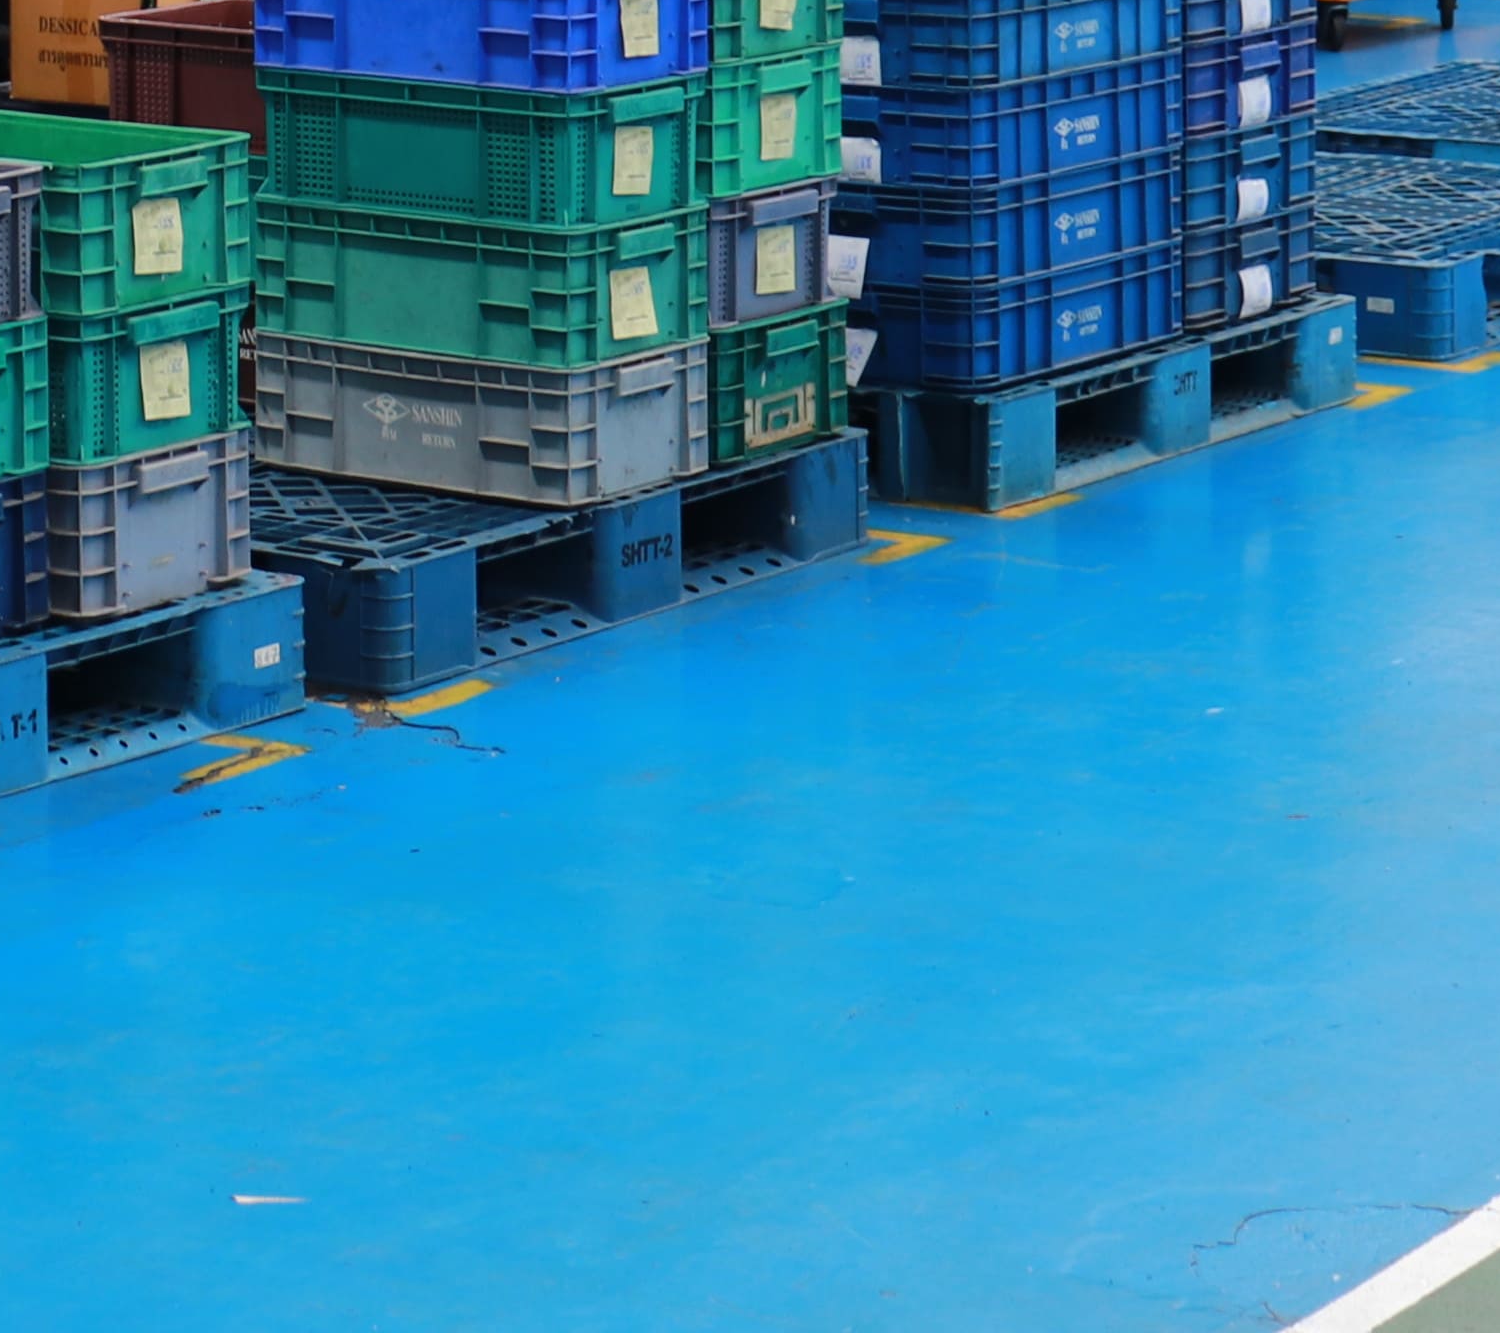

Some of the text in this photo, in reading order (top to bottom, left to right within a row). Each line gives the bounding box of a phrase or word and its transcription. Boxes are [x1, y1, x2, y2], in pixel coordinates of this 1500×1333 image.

[39, 16, 97, 37] DESSICA
[412, 404, 462, 427] SANSHIN
[621, 532, 674, 569] SHTT-2
